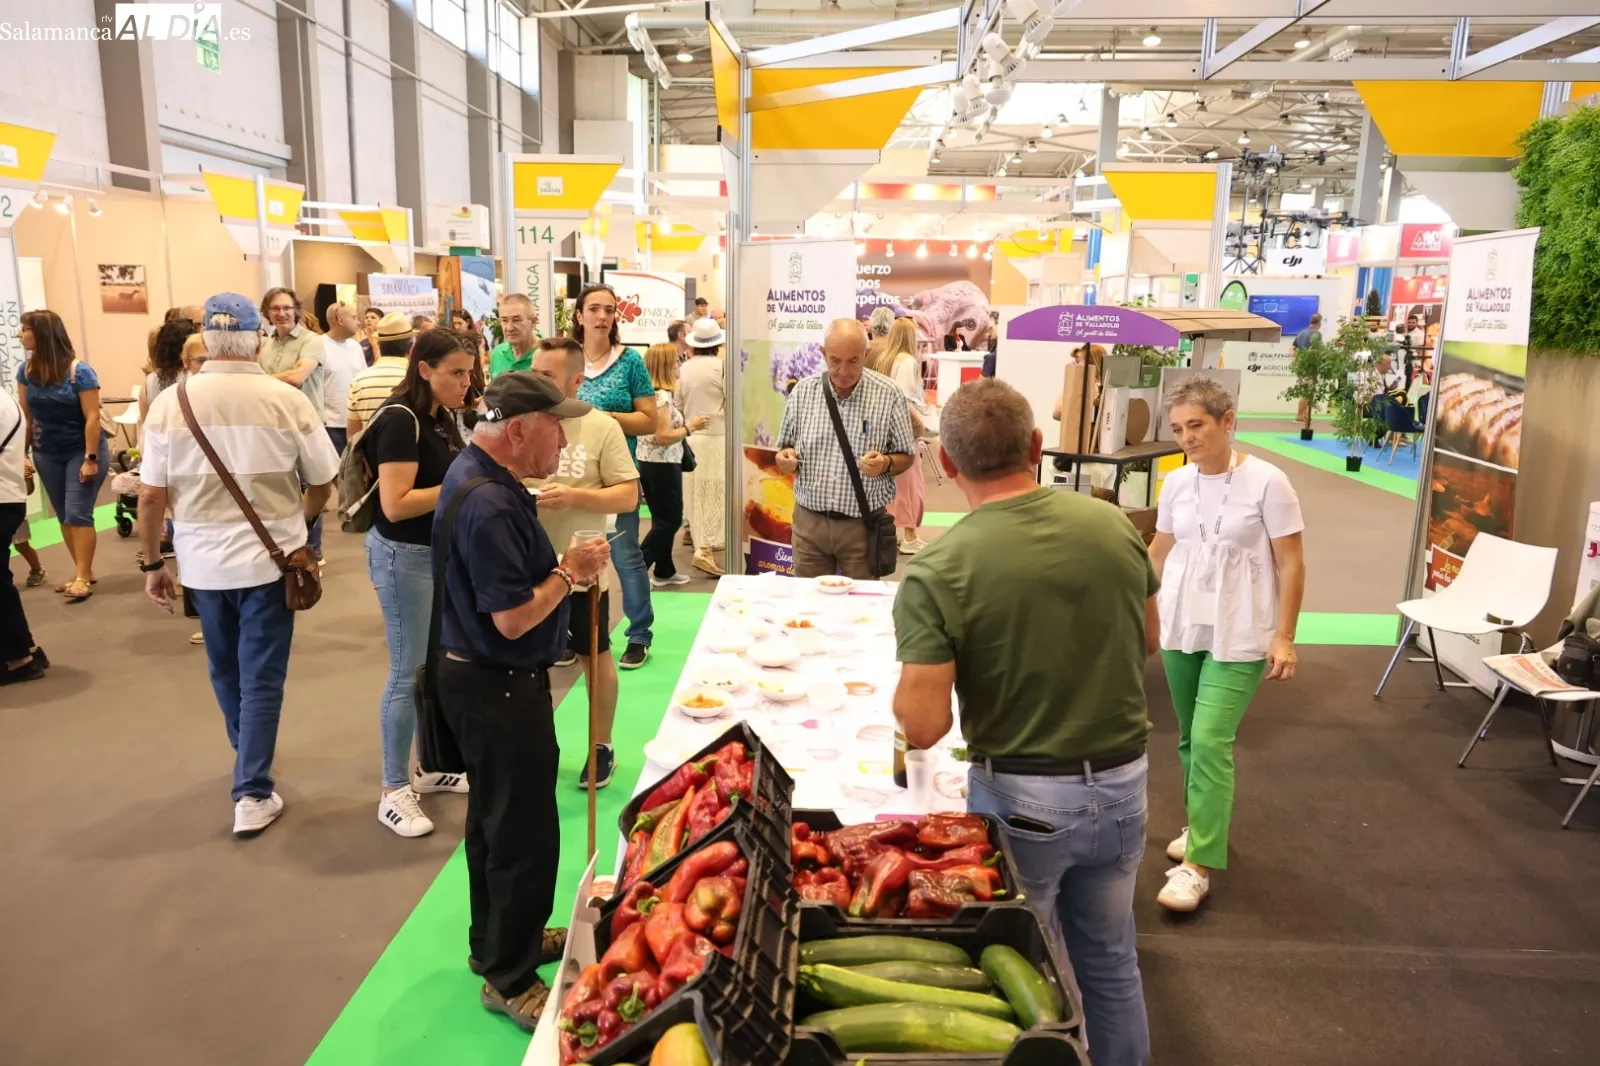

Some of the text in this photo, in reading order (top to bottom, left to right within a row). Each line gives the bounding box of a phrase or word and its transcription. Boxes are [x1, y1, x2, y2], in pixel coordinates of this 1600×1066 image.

[517, 225, 554, 244] 114
[767, 288, 826, 301] ALIMENTOS
[1467, 287, 1512, 300] ALIMENTOS
[767, 302, 826, 313] DE VALLADOLID
[1465, 301, 1511, 312] DE VALLADOLID
[1075, 313, 1121, 322] ALIMENTOS
[1085, 321, 1120, 329] VALLADOLID
